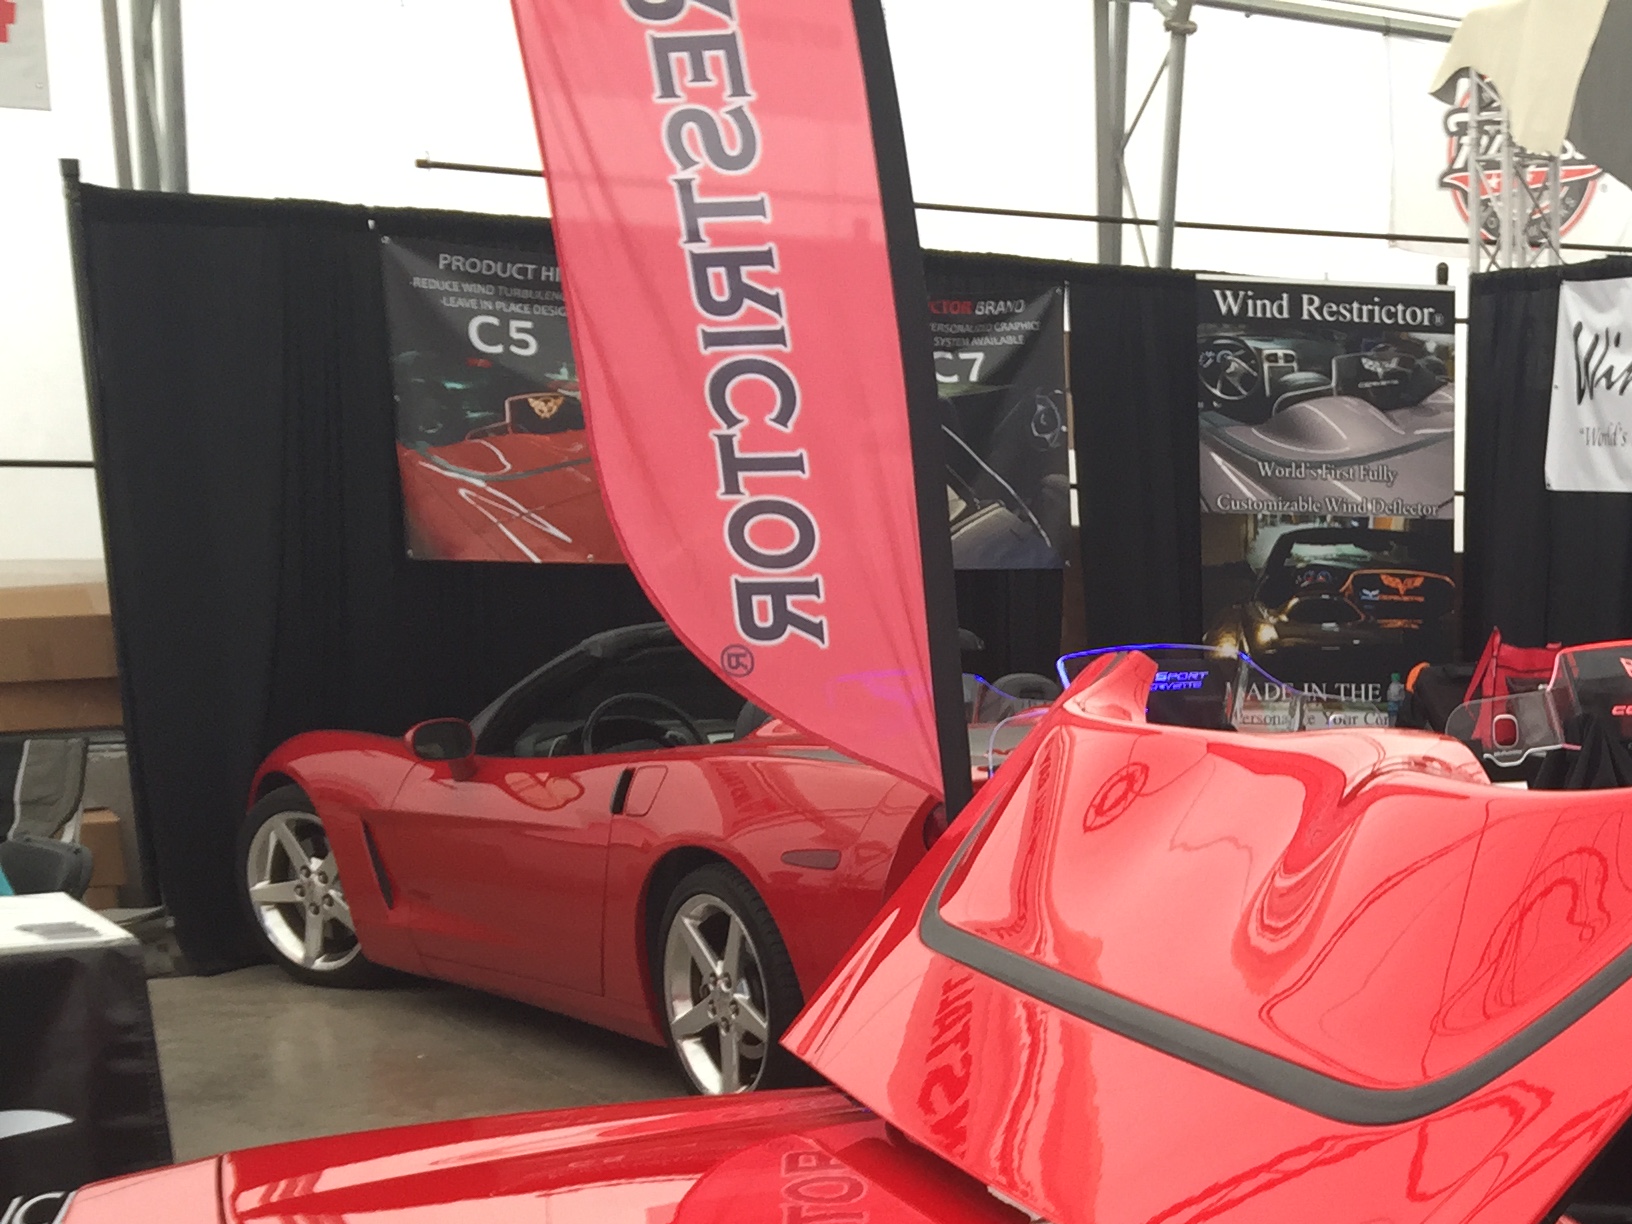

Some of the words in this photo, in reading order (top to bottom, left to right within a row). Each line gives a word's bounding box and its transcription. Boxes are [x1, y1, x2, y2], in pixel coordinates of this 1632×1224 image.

[438, 253, 537, 281] PRODUCT
[540, 266, 561, 283] HI
[462, 281, 495, 296] WIND
[498, 285, 564, 301] TURBULENC
[480, 298, 493, 310] IN
[496, 301, 531, 314] PLACE
[533, 305, 567, 318] DESIG
[1213, 289, 1290, 319] Wind
[467, 314, 539, 356] C5
[932, 351, 985, 383] C7
[1322, 463, 1355, 479] First
[1359, 463, 1398, 486] Fully
[1217, 494, 1321, 513] Customizable
[1325, 496, 1369, 514] Wind
[1371, 497, 1439, 516] Deflector
[1150, 681, 1203, 692] ORVETTE
[1155, 671, 1209, 682] SPORT
[1304, 683, 1327, 703] IN
[1335, 683, 1382, 703] THE
